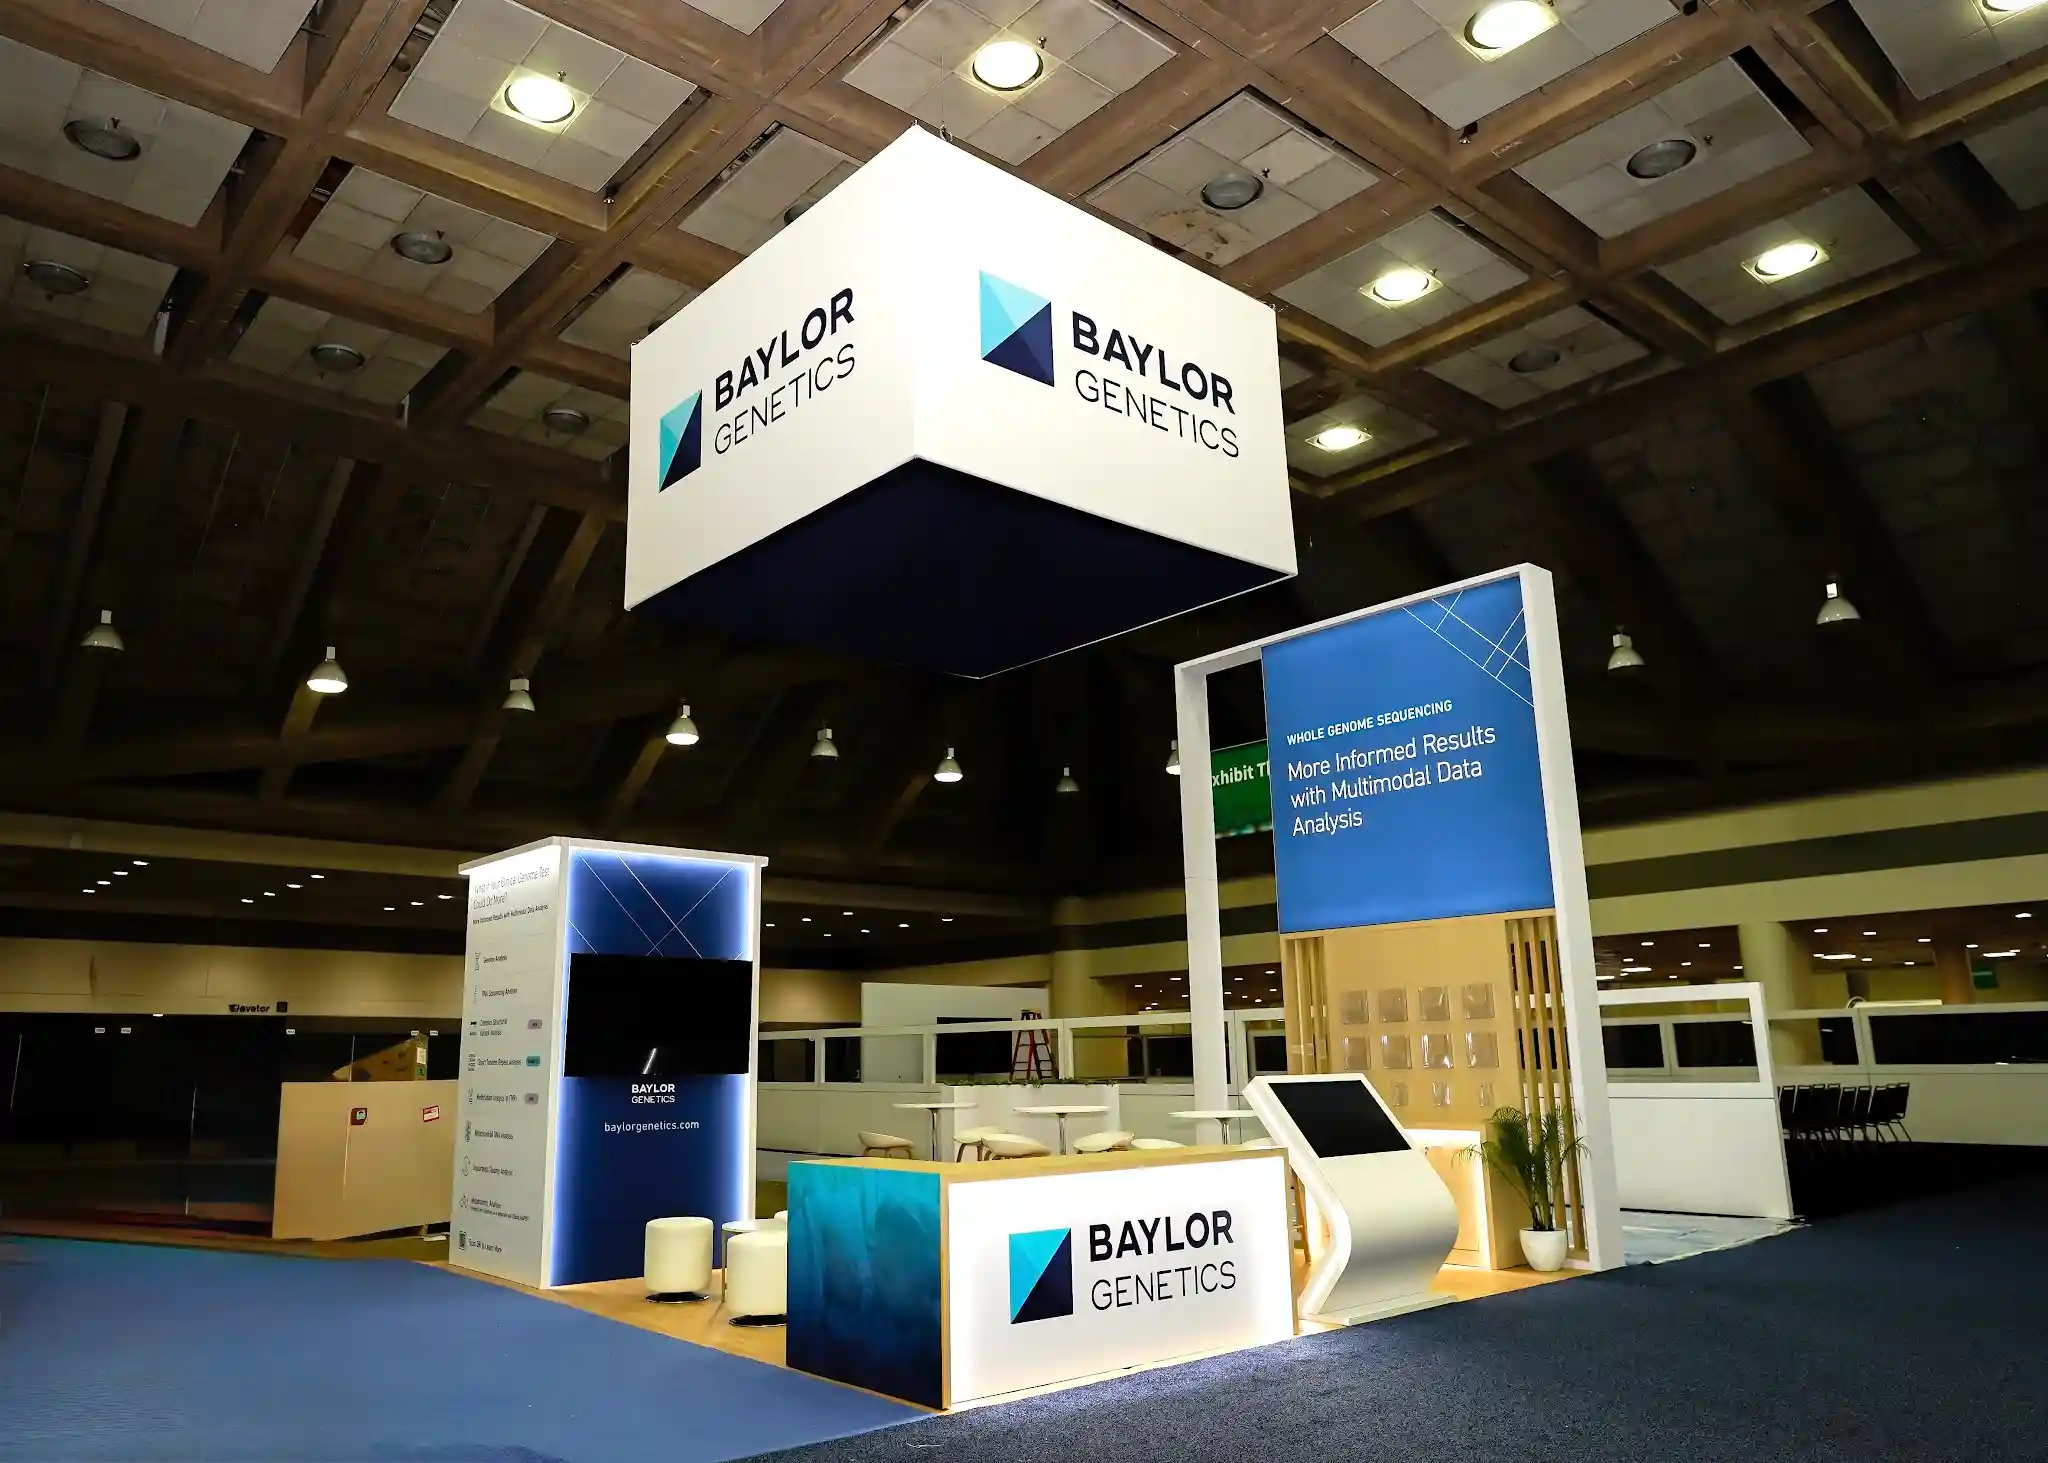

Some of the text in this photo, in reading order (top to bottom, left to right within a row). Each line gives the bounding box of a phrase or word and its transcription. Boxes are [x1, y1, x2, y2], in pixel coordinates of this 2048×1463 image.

[715, 288, 855, 412] BAYLOR
[1072, 310, 1236, 415] BAYLOR
[714, 343, 855, 455] GENETICS
[1075, 369, 1239, 458] GENETICS
[1287, 699, 1453, 745] WHOLE GENOME SEQUENCING
[1212, 765, 1254, 787] xhibit
[1288, 725, 1496, 781] More Informed Results
[1290, 759, 1482, 808] with Multimodal Data
[1293, 807, 1363, 836] Analysis
[631, 1083, 675, 1094] BAYLOR
[631, 1095, 675, 1104] GENETICS
[604, 1121, 700, 1133] baylorgenetics.com
[1089, 1210, 1234, 1262] BAYLOR
[1091, 1260, 1236, 1311] GENETICS
